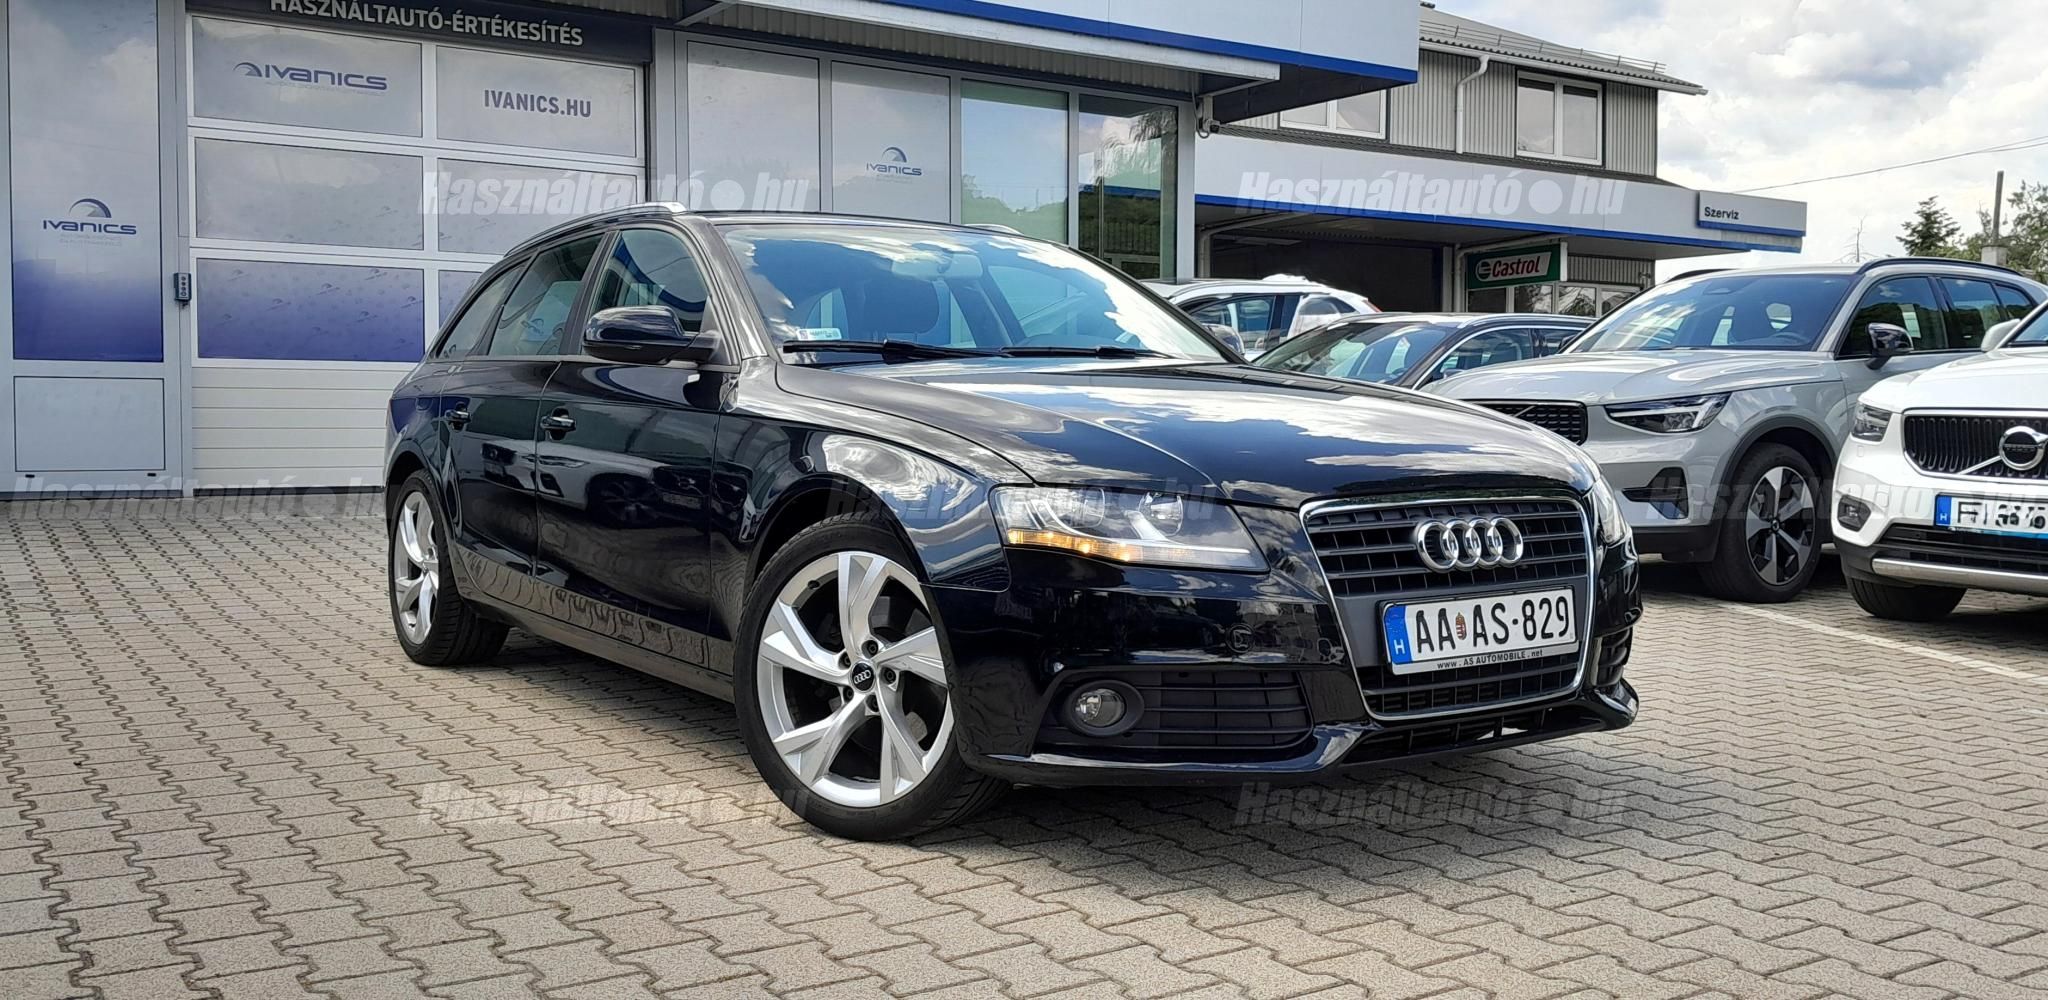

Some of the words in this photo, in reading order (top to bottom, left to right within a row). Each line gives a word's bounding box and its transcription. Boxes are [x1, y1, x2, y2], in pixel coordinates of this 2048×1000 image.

[484, 89, 592, 118] IVANICS.HU
[1704, 206, 1740, 220] Szerviz
[1492, 256, 1540, 277] Castrol
[1415, 608, 1456, 653] AA
[1394, 639, 1406, 655] H
[1463, 657, 1474, 666] AS
[1476, 650, 1526, 664] AUTOMOBILE
